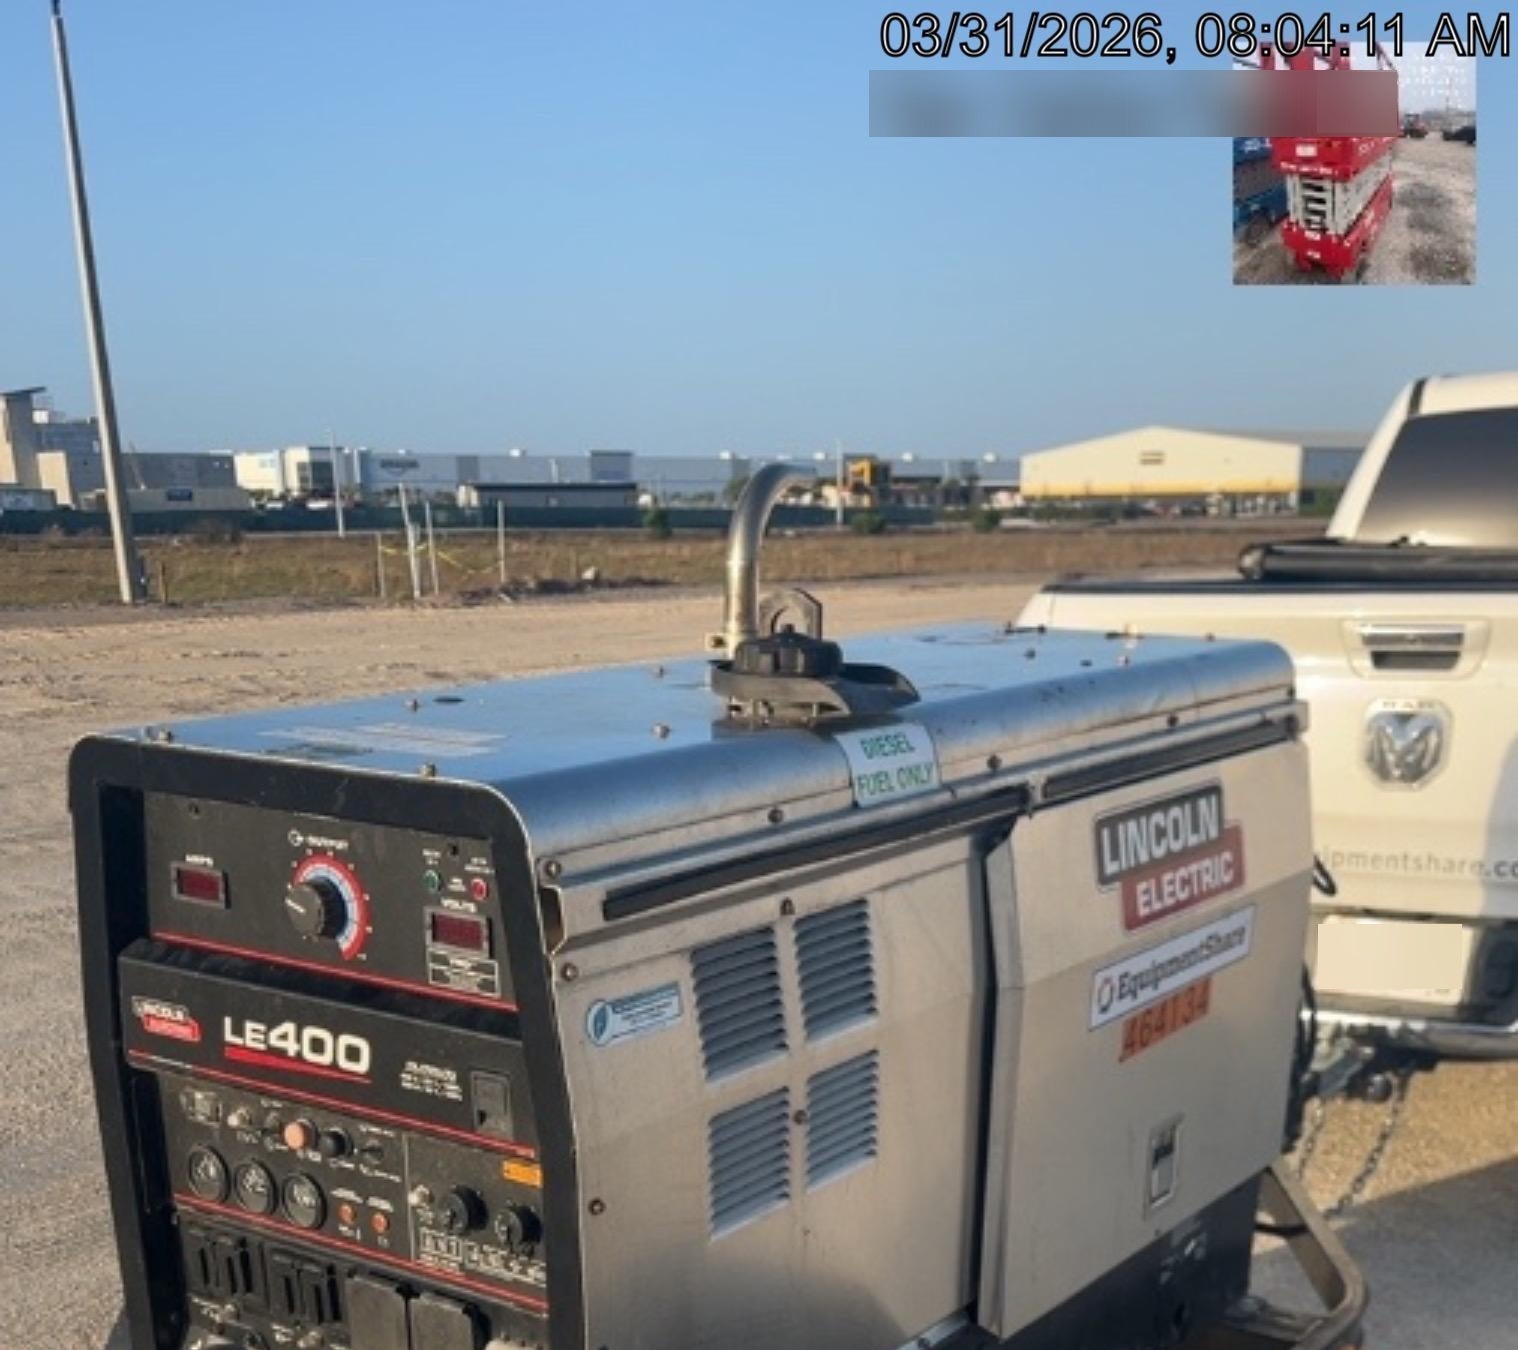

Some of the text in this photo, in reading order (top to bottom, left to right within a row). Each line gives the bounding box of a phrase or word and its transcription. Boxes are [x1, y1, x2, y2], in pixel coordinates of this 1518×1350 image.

[860, 732, 916, 760] DIESEL
[857, 762, 934, 797] FUEL ONLY
[1102, 794, 1219, 876] LINCOLN
[1136, 851, 1234, 918] ELECTRIC
[1118, 926, 1247, 1001] EquipmentShare
[224, 1016, 370, 1074] LE400
